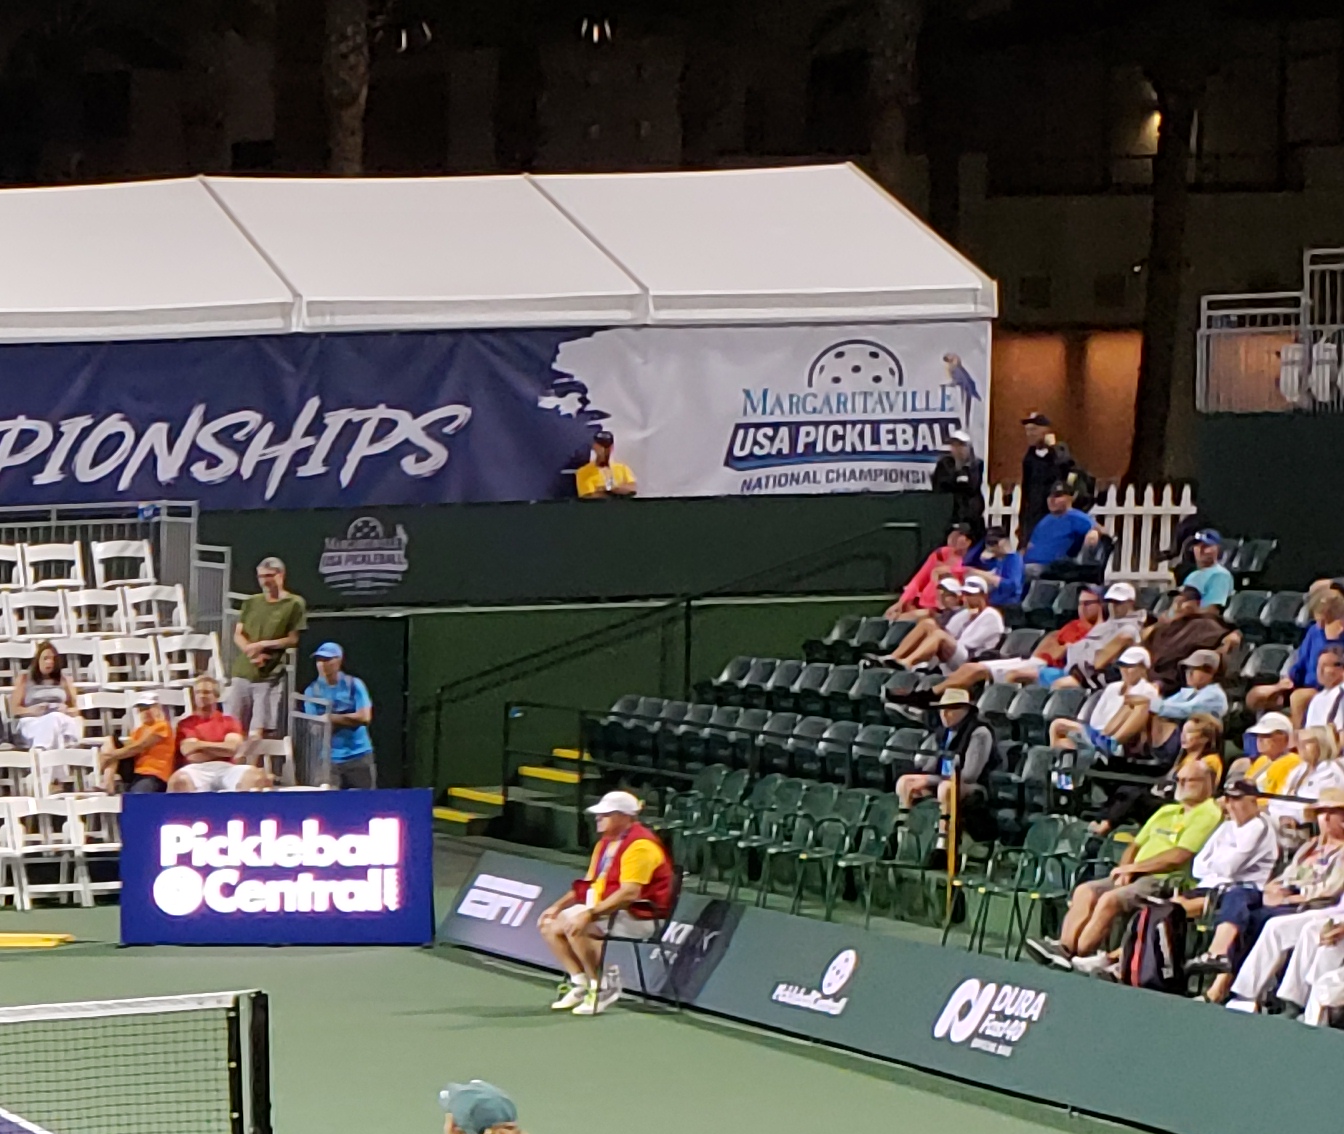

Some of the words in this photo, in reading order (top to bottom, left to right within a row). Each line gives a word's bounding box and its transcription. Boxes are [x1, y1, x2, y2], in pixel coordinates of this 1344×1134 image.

[742, 385, 955, 416] MARGARITAVILLE
[732, 426, 791, 458] USA
[741, 470, 821, 492] NATIONAL
[160, 817, 401, 868] Pickleball
[992, 984, 1048, 1021] DURA
